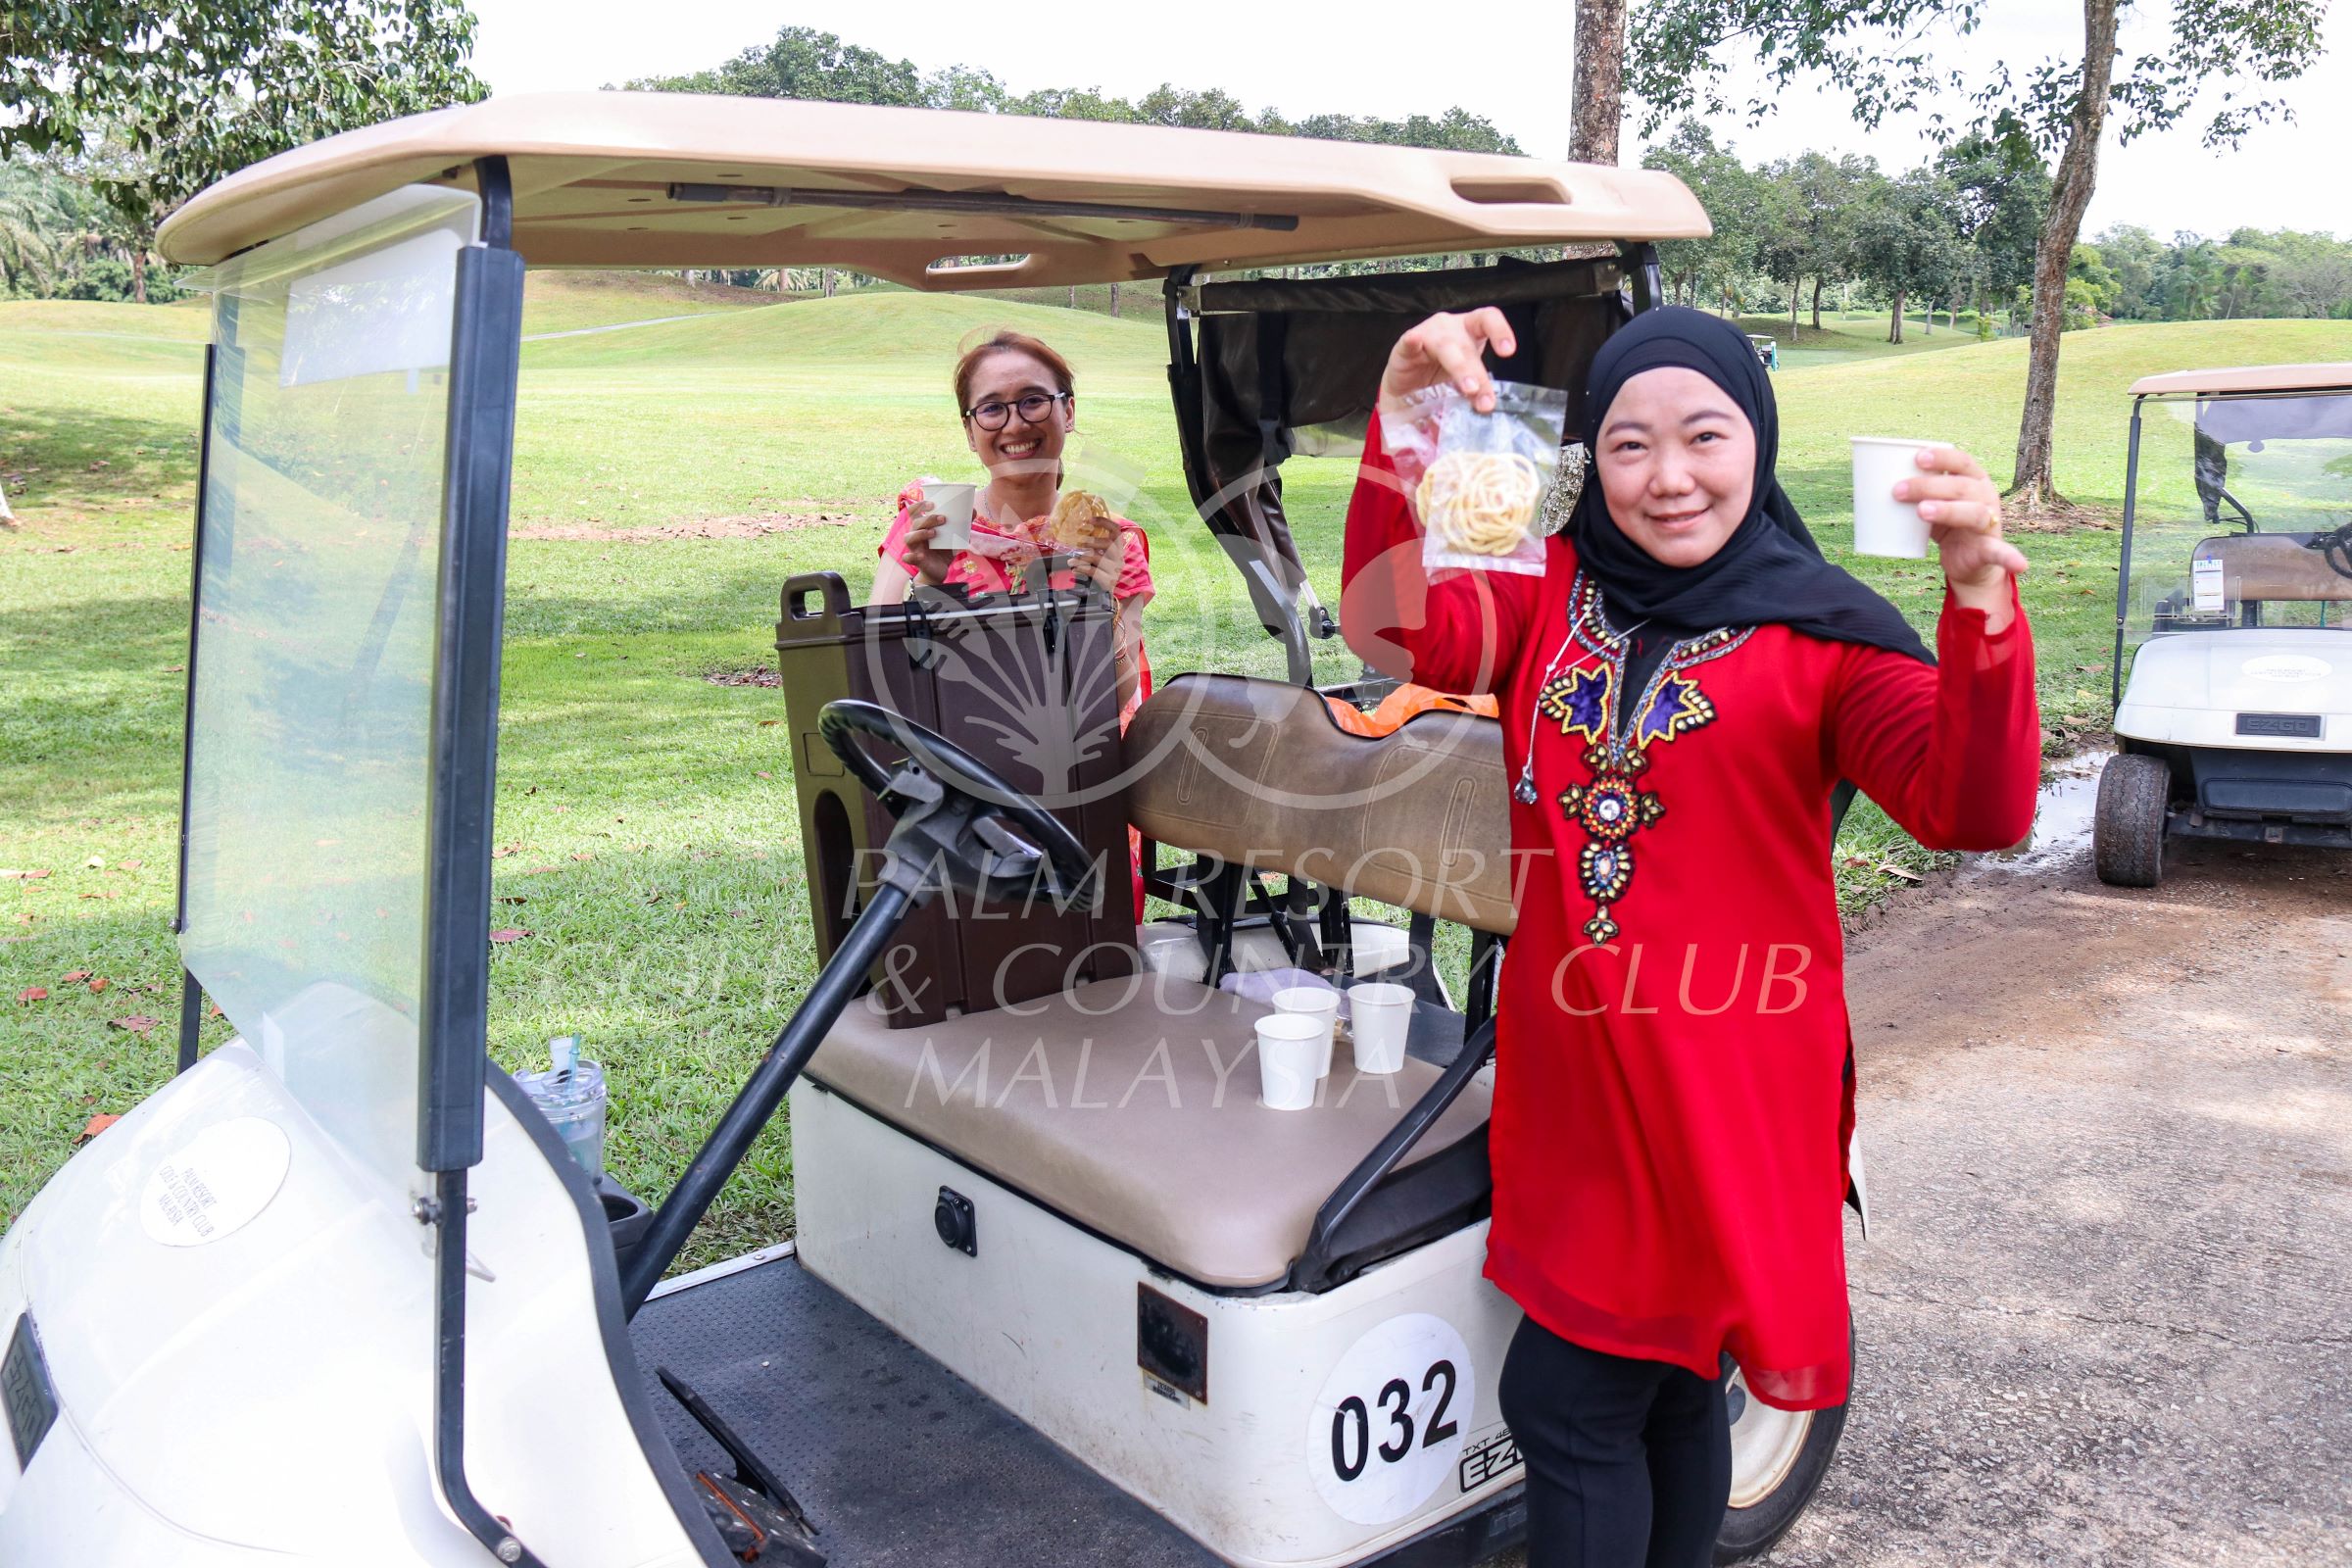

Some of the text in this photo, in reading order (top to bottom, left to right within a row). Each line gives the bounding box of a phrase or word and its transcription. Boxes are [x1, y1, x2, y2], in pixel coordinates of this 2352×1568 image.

[192, 1214, 216, 1237] CLUB
[1332, 1359, 1457, 1482] 032
[1462, 1437, 1491, 1456] TXT
